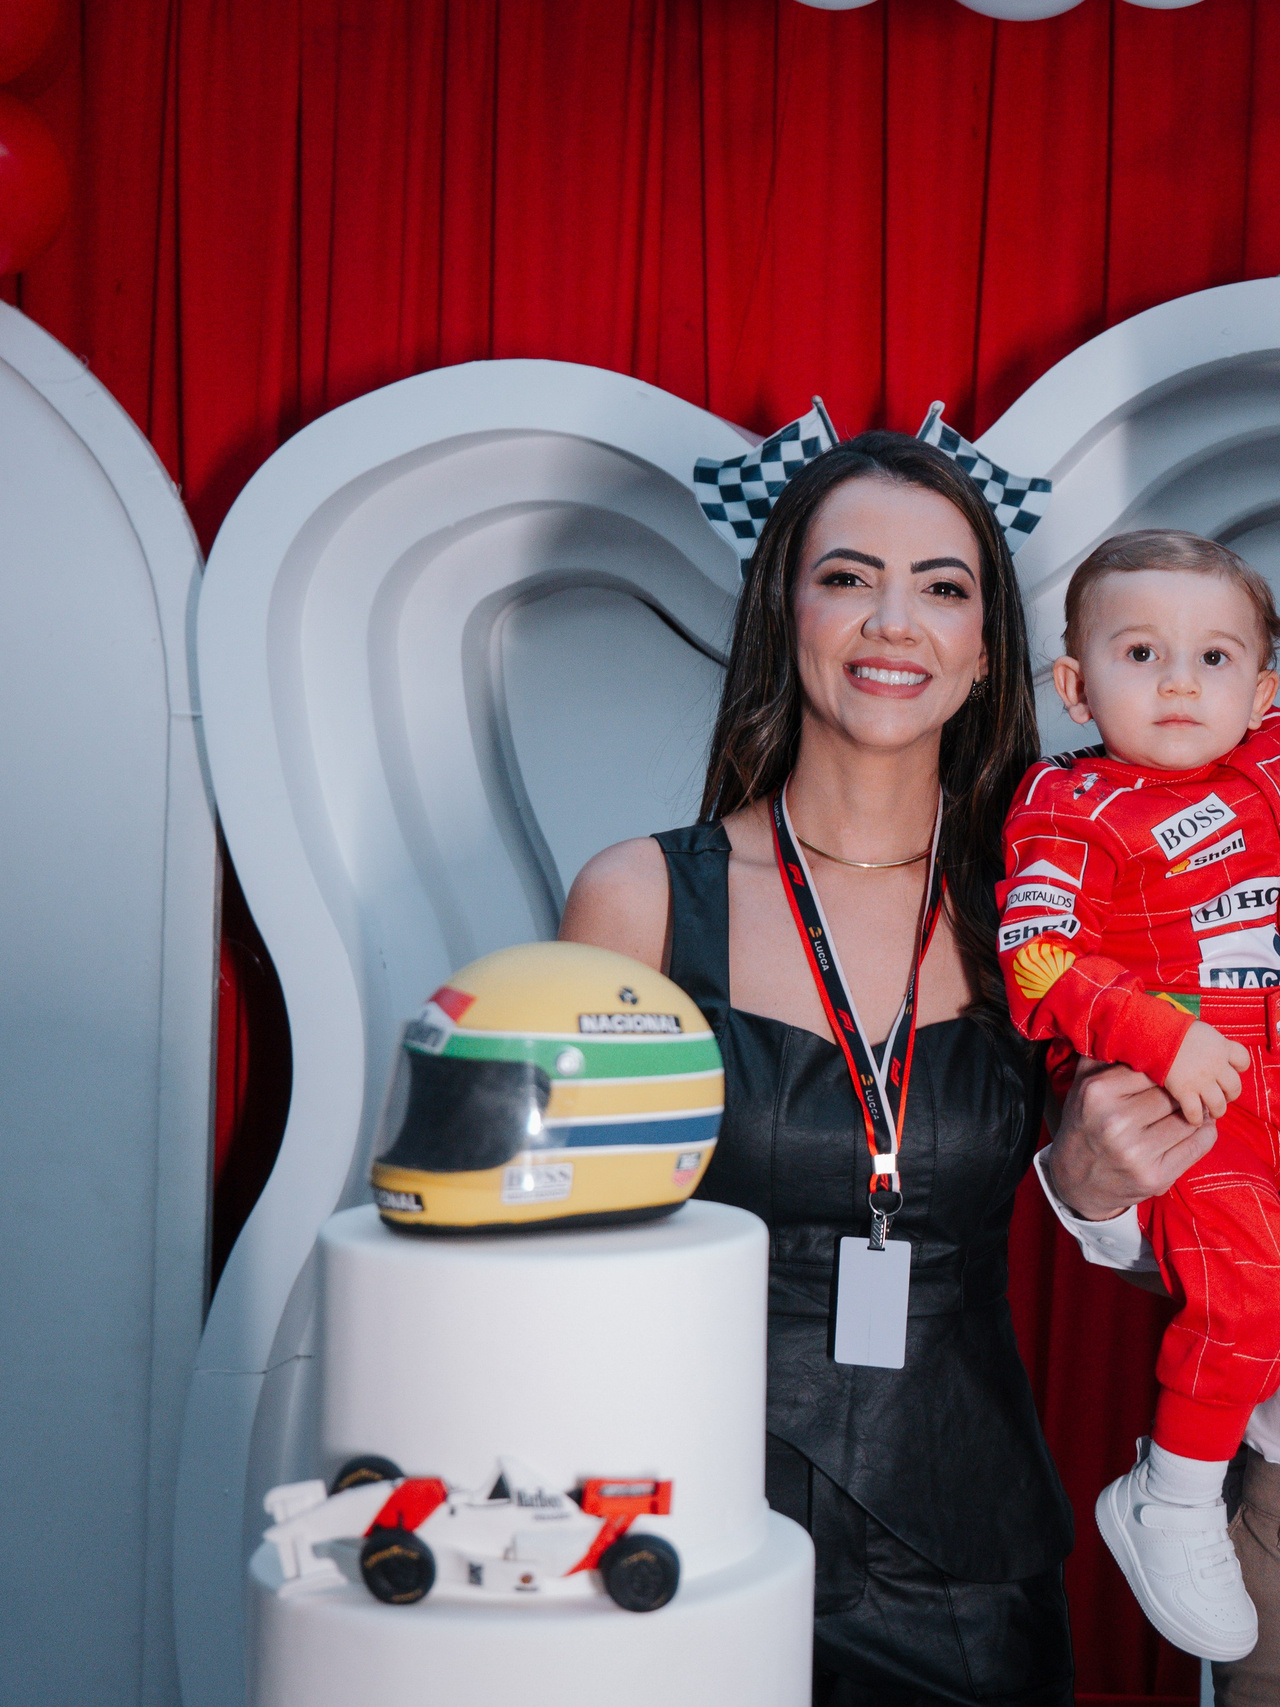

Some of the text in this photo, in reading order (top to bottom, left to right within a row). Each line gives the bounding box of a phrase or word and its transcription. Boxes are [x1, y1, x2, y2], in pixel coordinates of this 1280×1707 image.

[773, 800, 782, 829] LUCCA
[1159, 803, 1225, 851] BOSS
[1194, 837, 1245, 866] Shell
[814, 940, 830, 972] LUCCA
[580, 1012, 682, 1034] NACIONAL
[865, 1089, 880, 1120] LUCCA
[507, 1167, 571, 1187] BSS
